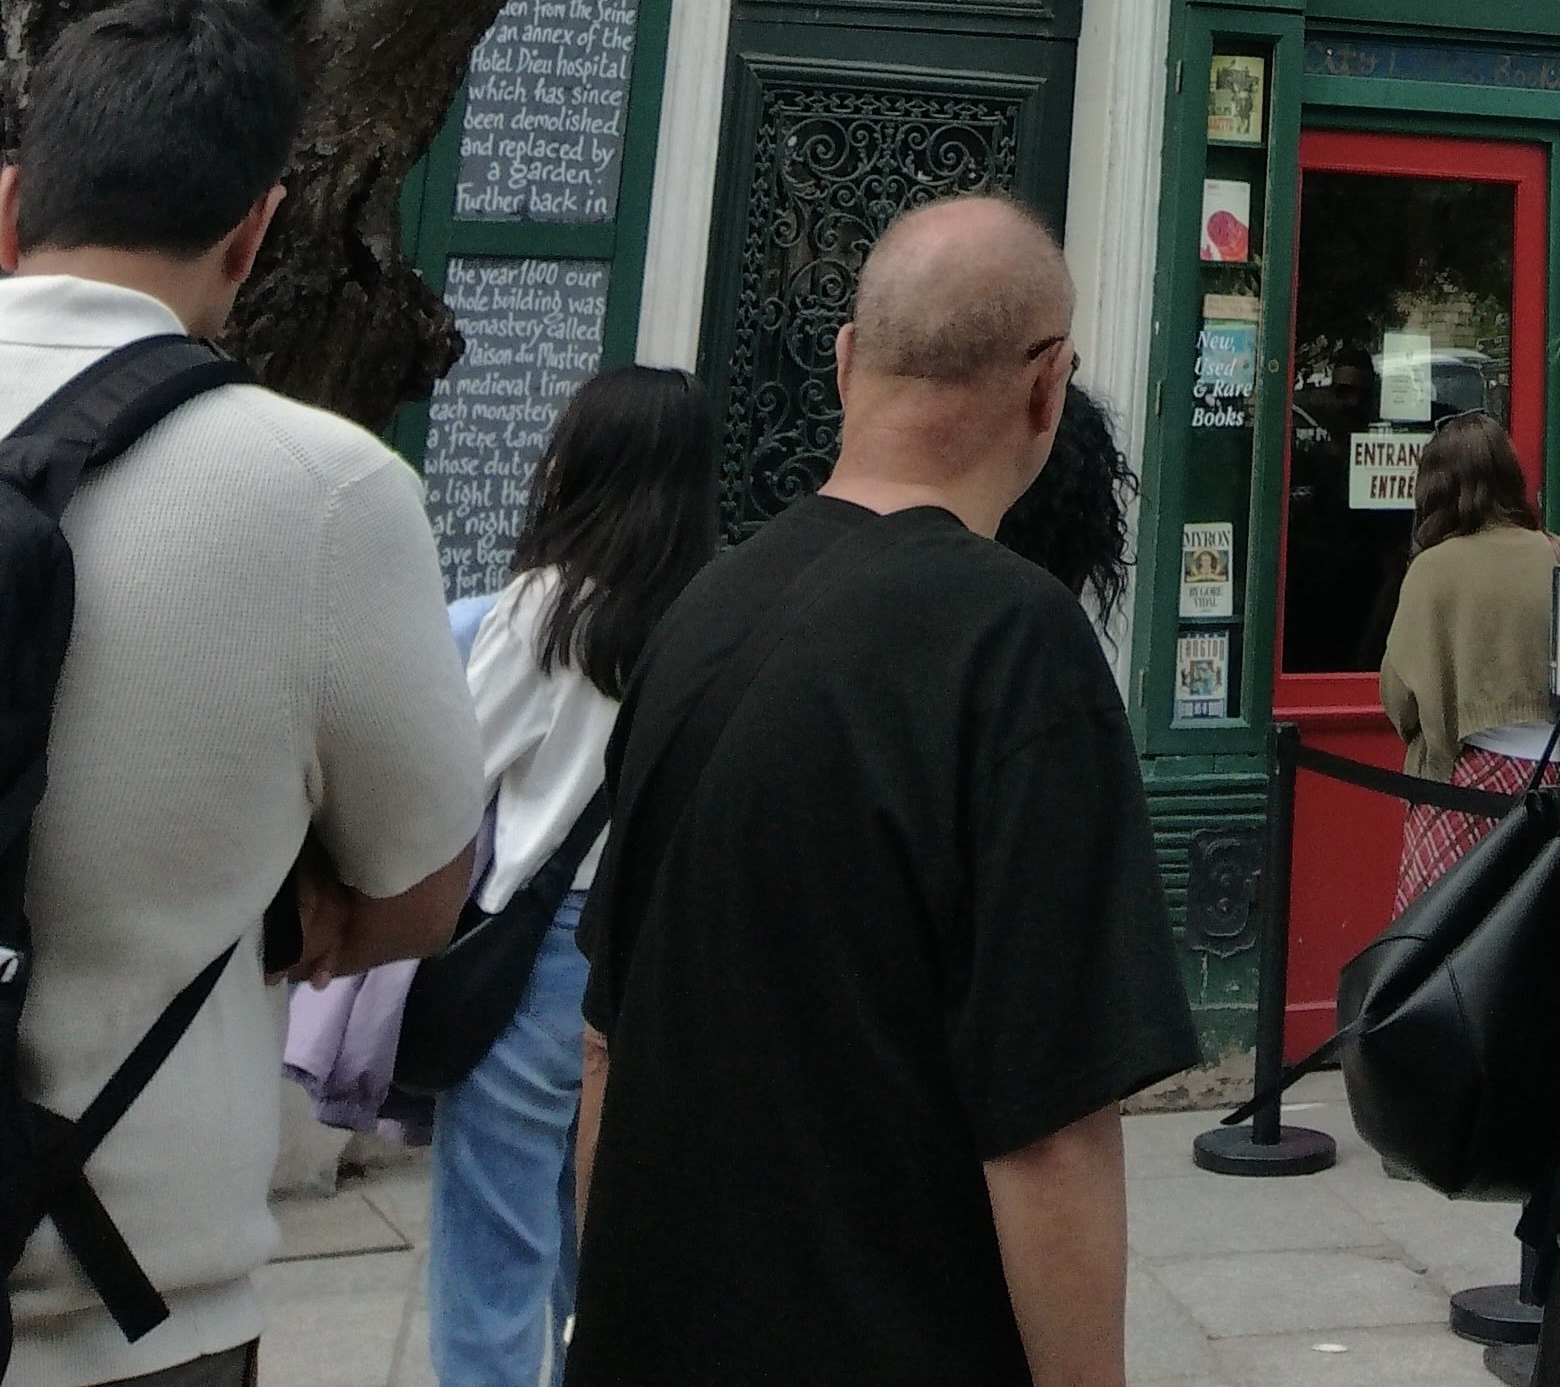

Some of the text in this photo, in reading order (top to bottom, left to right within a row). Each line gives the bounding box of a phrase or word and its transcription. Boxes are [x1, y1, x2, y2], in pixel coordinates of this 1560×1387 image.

[496, 21, 634, 54] an annex of the
[470, 45, 628, 85] Hotel Dieu hospital
[468, 75, 624, 107] which has since
[463, 104, 621, 137] been demolished
[460, 131, 616, 174] and replaced by
[486, 161, 502, 182] a
[456, 181, 609, 216] Further back in
[446, 257, 603, 297] the year 1600 our
[442, 285, 607, 325] whole building was
[453, 311, 602, 348] monastery called
[1196, 330, 1237, 353] New,
[515, 342, 535, 365] du
[1194, 355, 1238, 378] Used
[456, 370, 532, 398] medieval
[1193, 378, 1254, 399] & Rare
[429, 397, 560, 432] each monastery
[1191, 405, 1246, 428] Books
[426, 428, 440, 450] a
[1354, 441, 1421, 467] ENTRAN
[423, 449, 538, 488] whose duty
[444, 477, 530, 518] light the
[1370, 470, 1416, 500] ENTRÉ
[464, 508, 520, 549] night
[1183, 530, 1231, 549] MYRON
